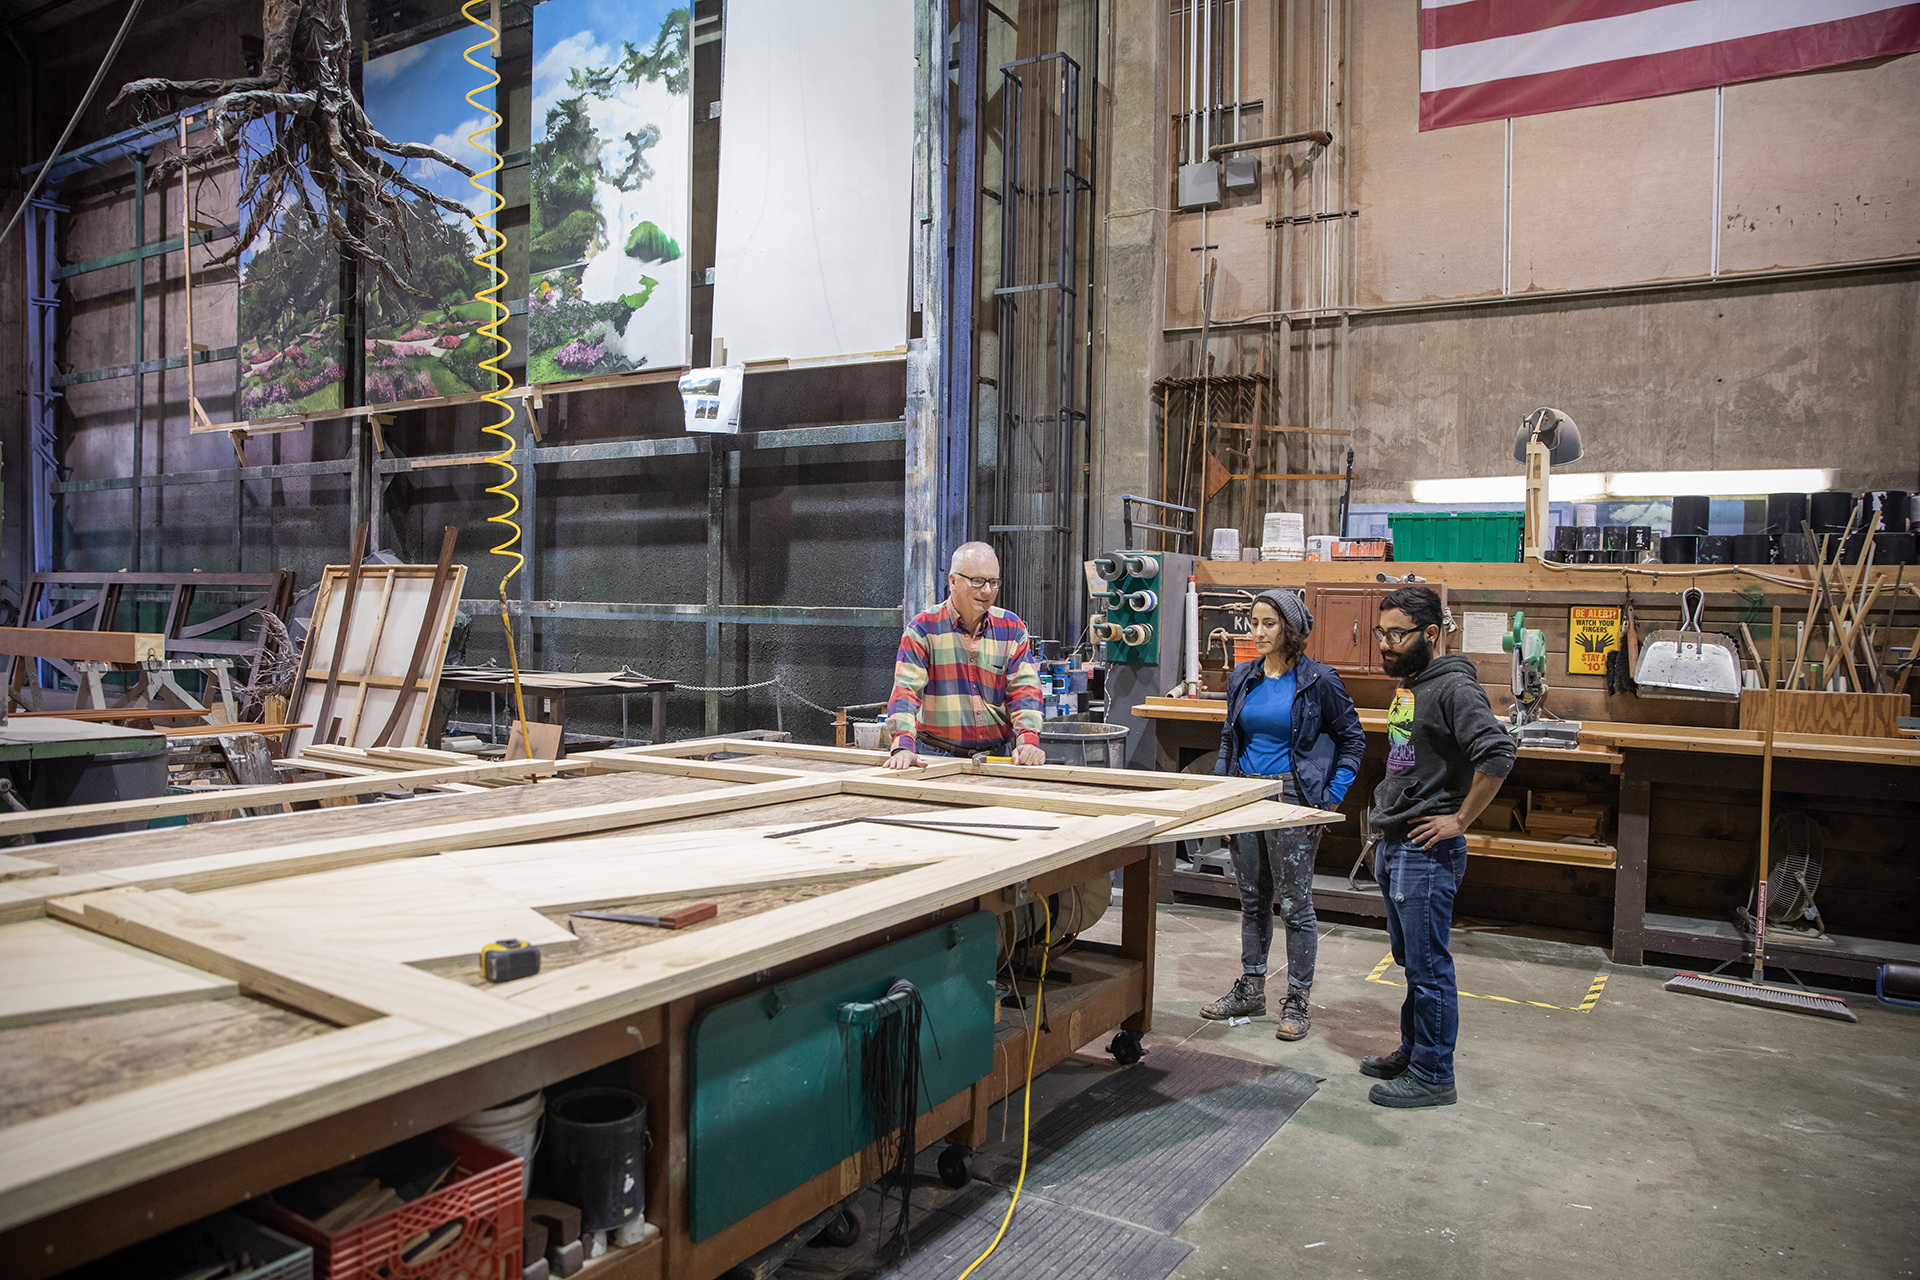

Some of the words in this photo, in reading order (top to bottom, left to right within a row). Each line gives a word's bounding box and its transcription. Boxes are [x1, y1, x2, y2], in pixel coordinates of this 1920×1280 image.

[1575, 609, 1585, 618] BE
[1588, 609, 1616, 619] ALERT!
[1581, 653, 1600, 662] STAY
